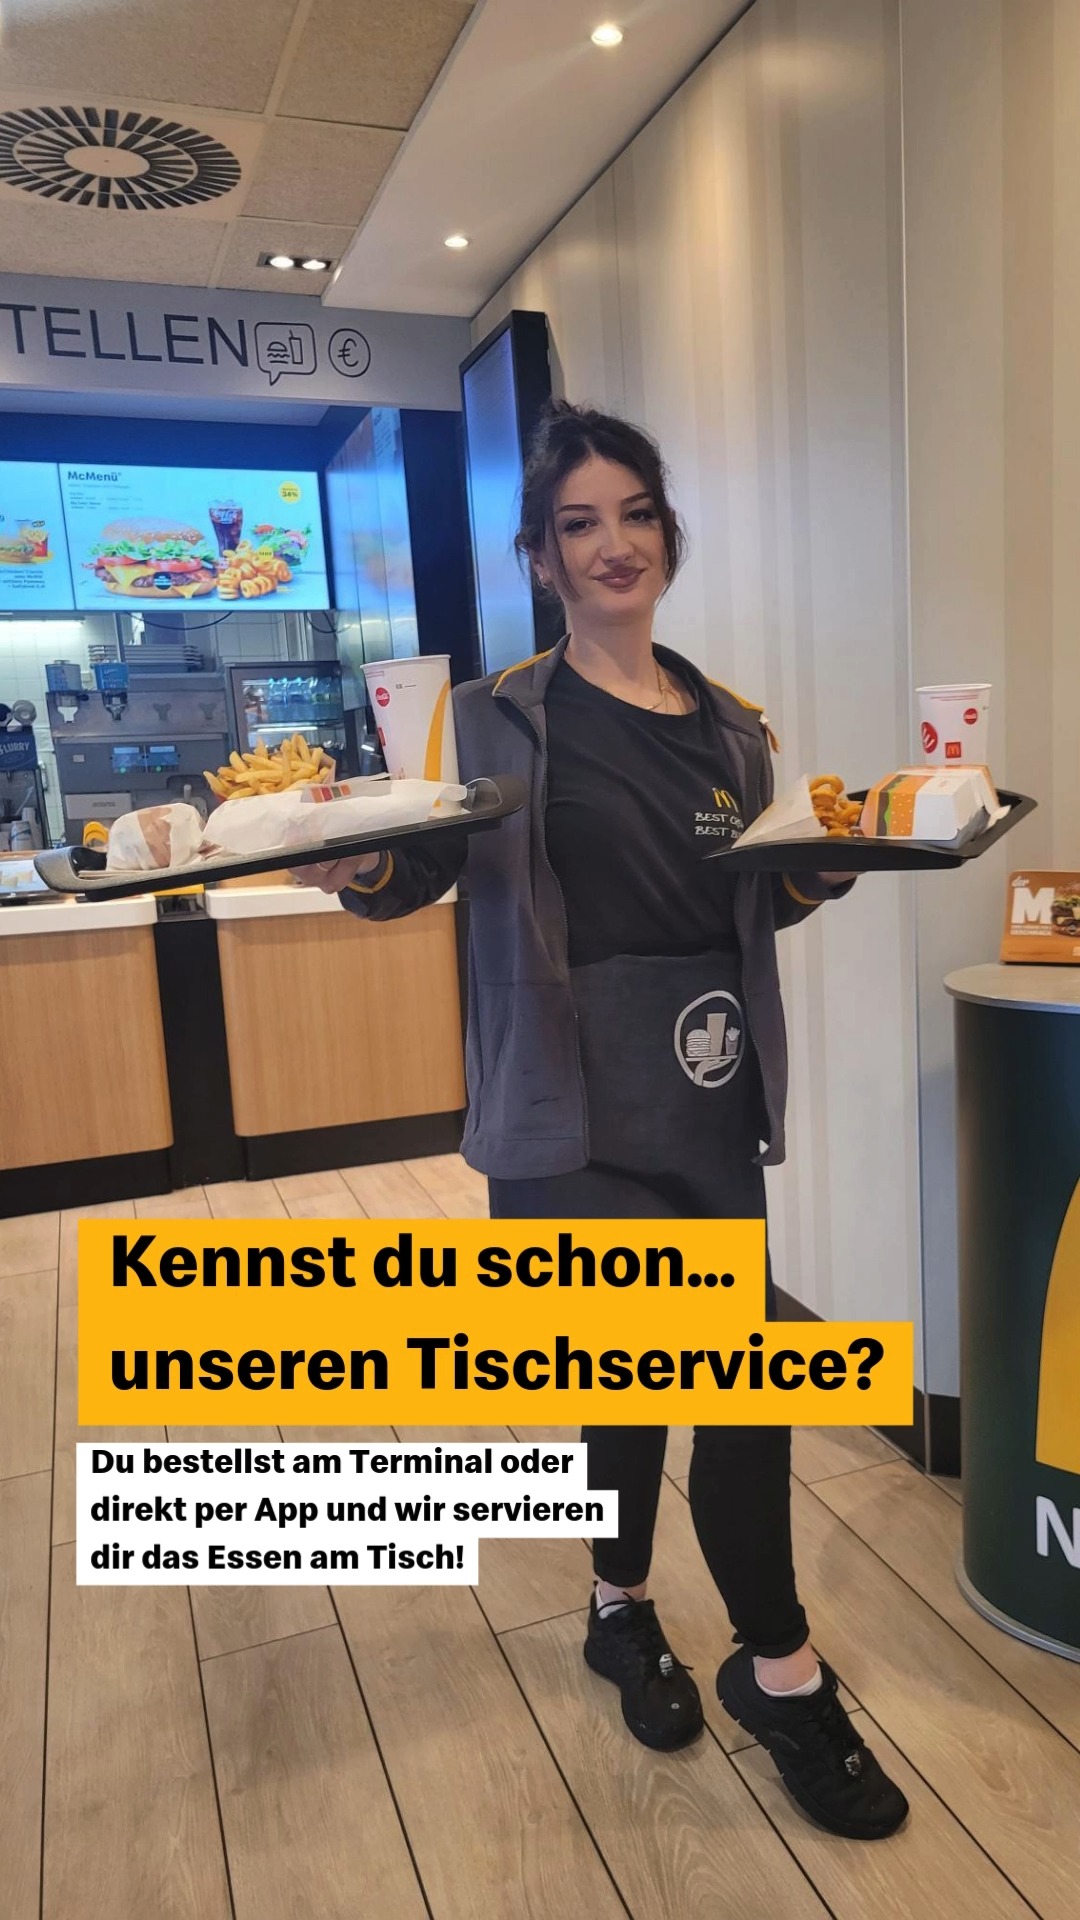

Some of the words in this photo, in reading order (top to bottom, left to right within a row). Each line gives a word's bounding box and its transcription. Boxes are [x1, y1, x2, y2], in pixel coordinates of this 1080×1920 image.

[0, 303, 249, 367] TELLEN
[694, 812, 729, 823] BEST
[694, 825, 730, 836] BEST
